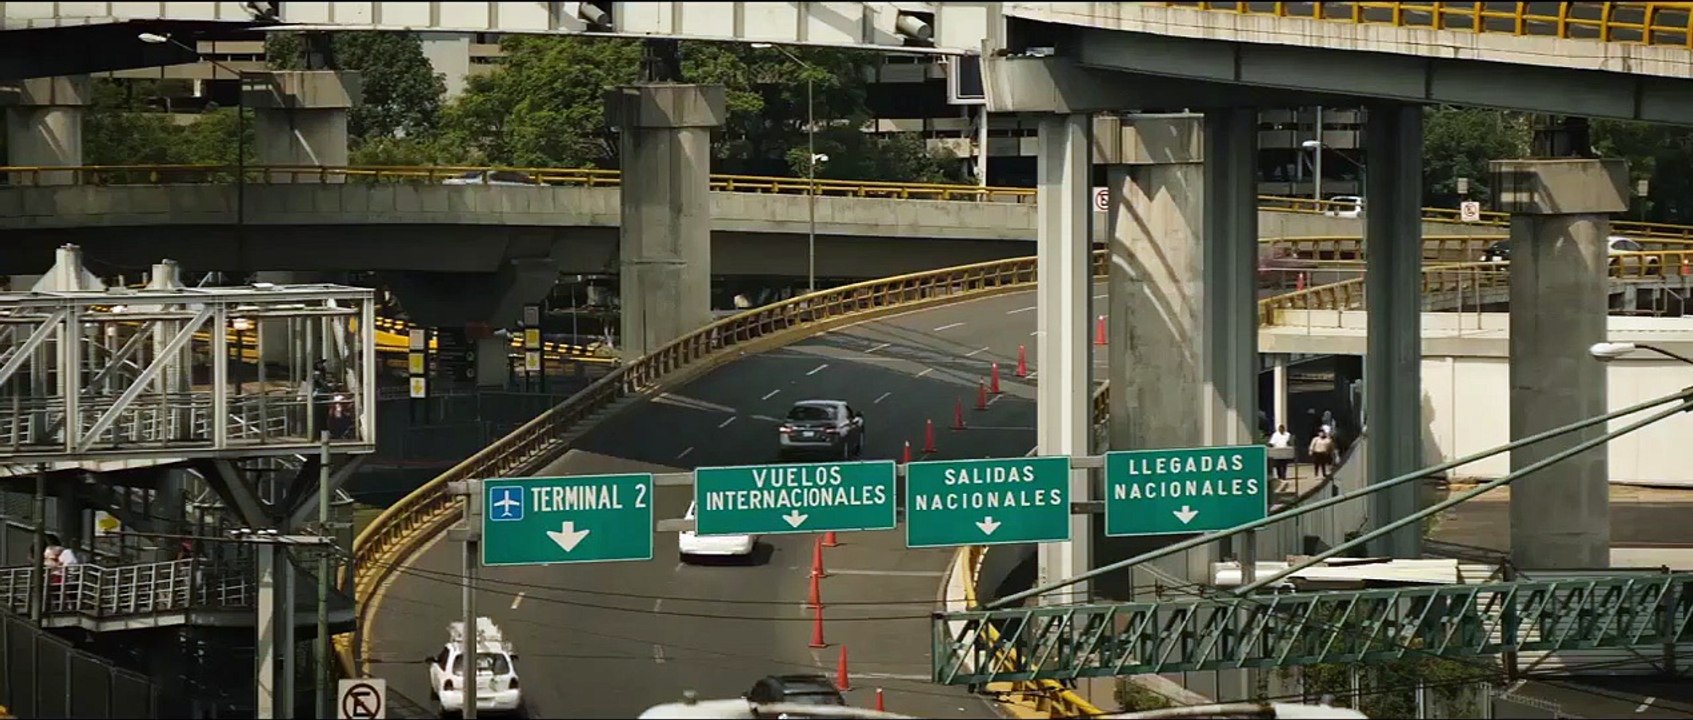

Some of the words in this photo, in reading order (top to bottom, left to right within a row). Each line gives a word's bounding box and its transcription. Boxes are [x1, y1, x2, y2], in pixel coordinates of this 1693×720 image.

[944, 465, 1034, 485] SALIDAS
[1129, 454, 1243, 475] LLEGADAS
[752, 466, 842, 488] VUELOS
[531, 484, 623, 512] TERMINAL
[635, 483, 647, 508] 2
[706, 485, 886, 511] INTERNACIONALES
[915, 489, 1062, 510] NACIONALES
[1114, 479, 1258, 500] NACIONALES
